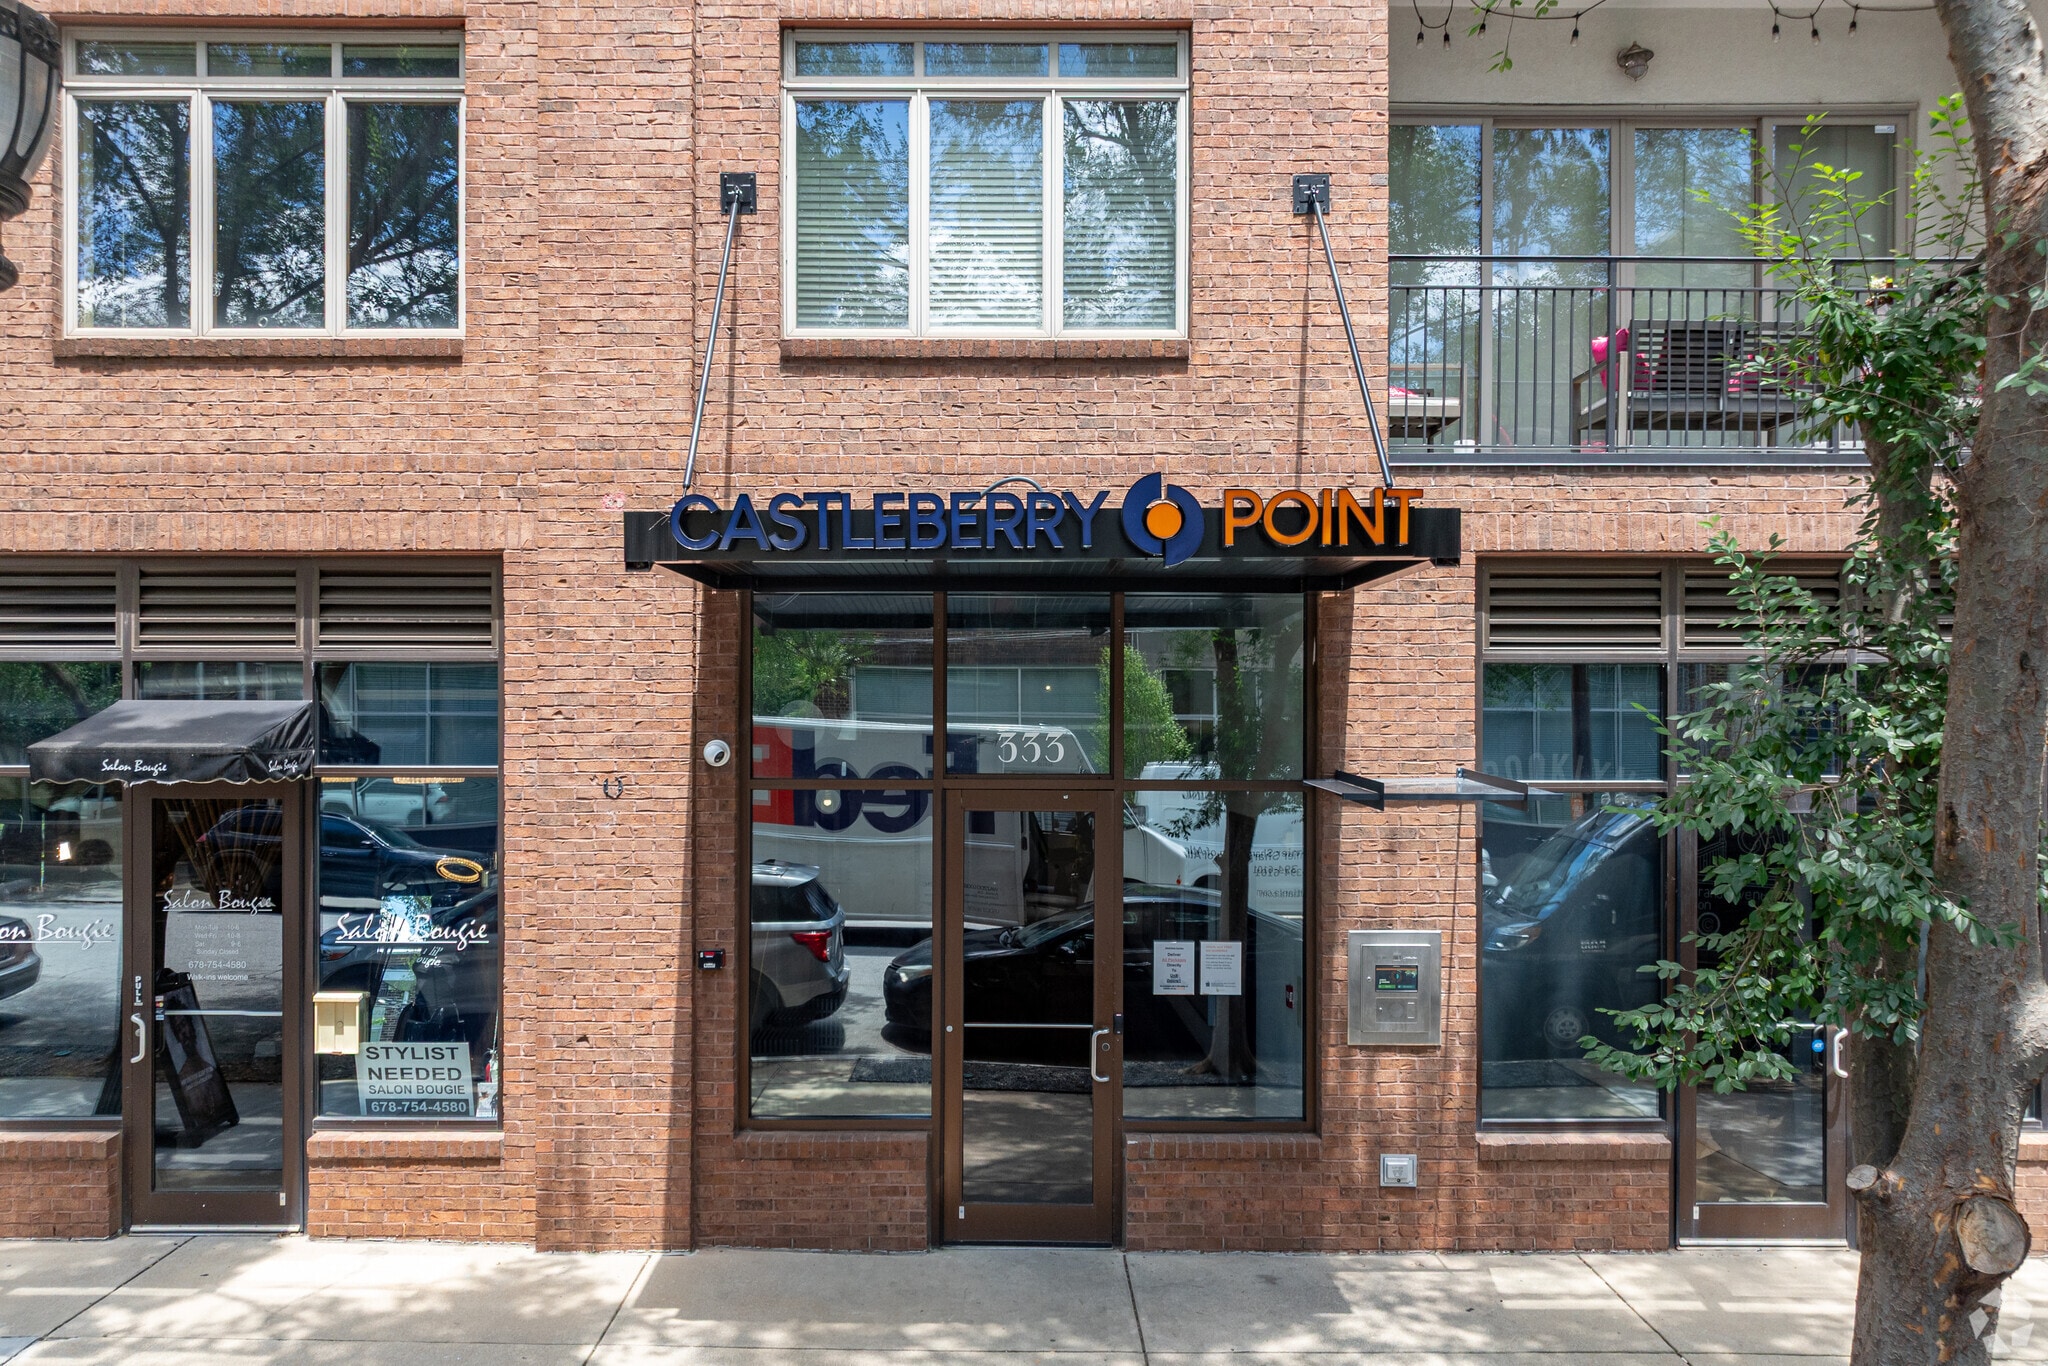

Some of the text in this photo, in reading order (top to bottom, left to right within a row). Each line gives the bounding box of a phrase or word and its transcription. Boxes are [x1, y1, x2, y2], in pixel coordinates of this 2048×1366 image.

[669, 488, 1424, 551] CASTLEBERRY POINT
[997, 732, 1066, 763] 333
[101, 759, 167, 777] Salon Bougie
[163, 889, 277, 916] Salon Bougie
[37, 913, 115, 951] Bougie
[414, 914, 488, 951] Bougie
[188, 960, 247, 969] 678-754-4580
[187, 973, 248, 981] Walk-ins welcome
[366, 1046, 459, 1060] STYLIST
[368, 1067, 463, 1081] NEEDED
[368, 1085, 466, 1095] SALON BOUGIE
[371, 1101, 467, 1113] 678-754-4580
